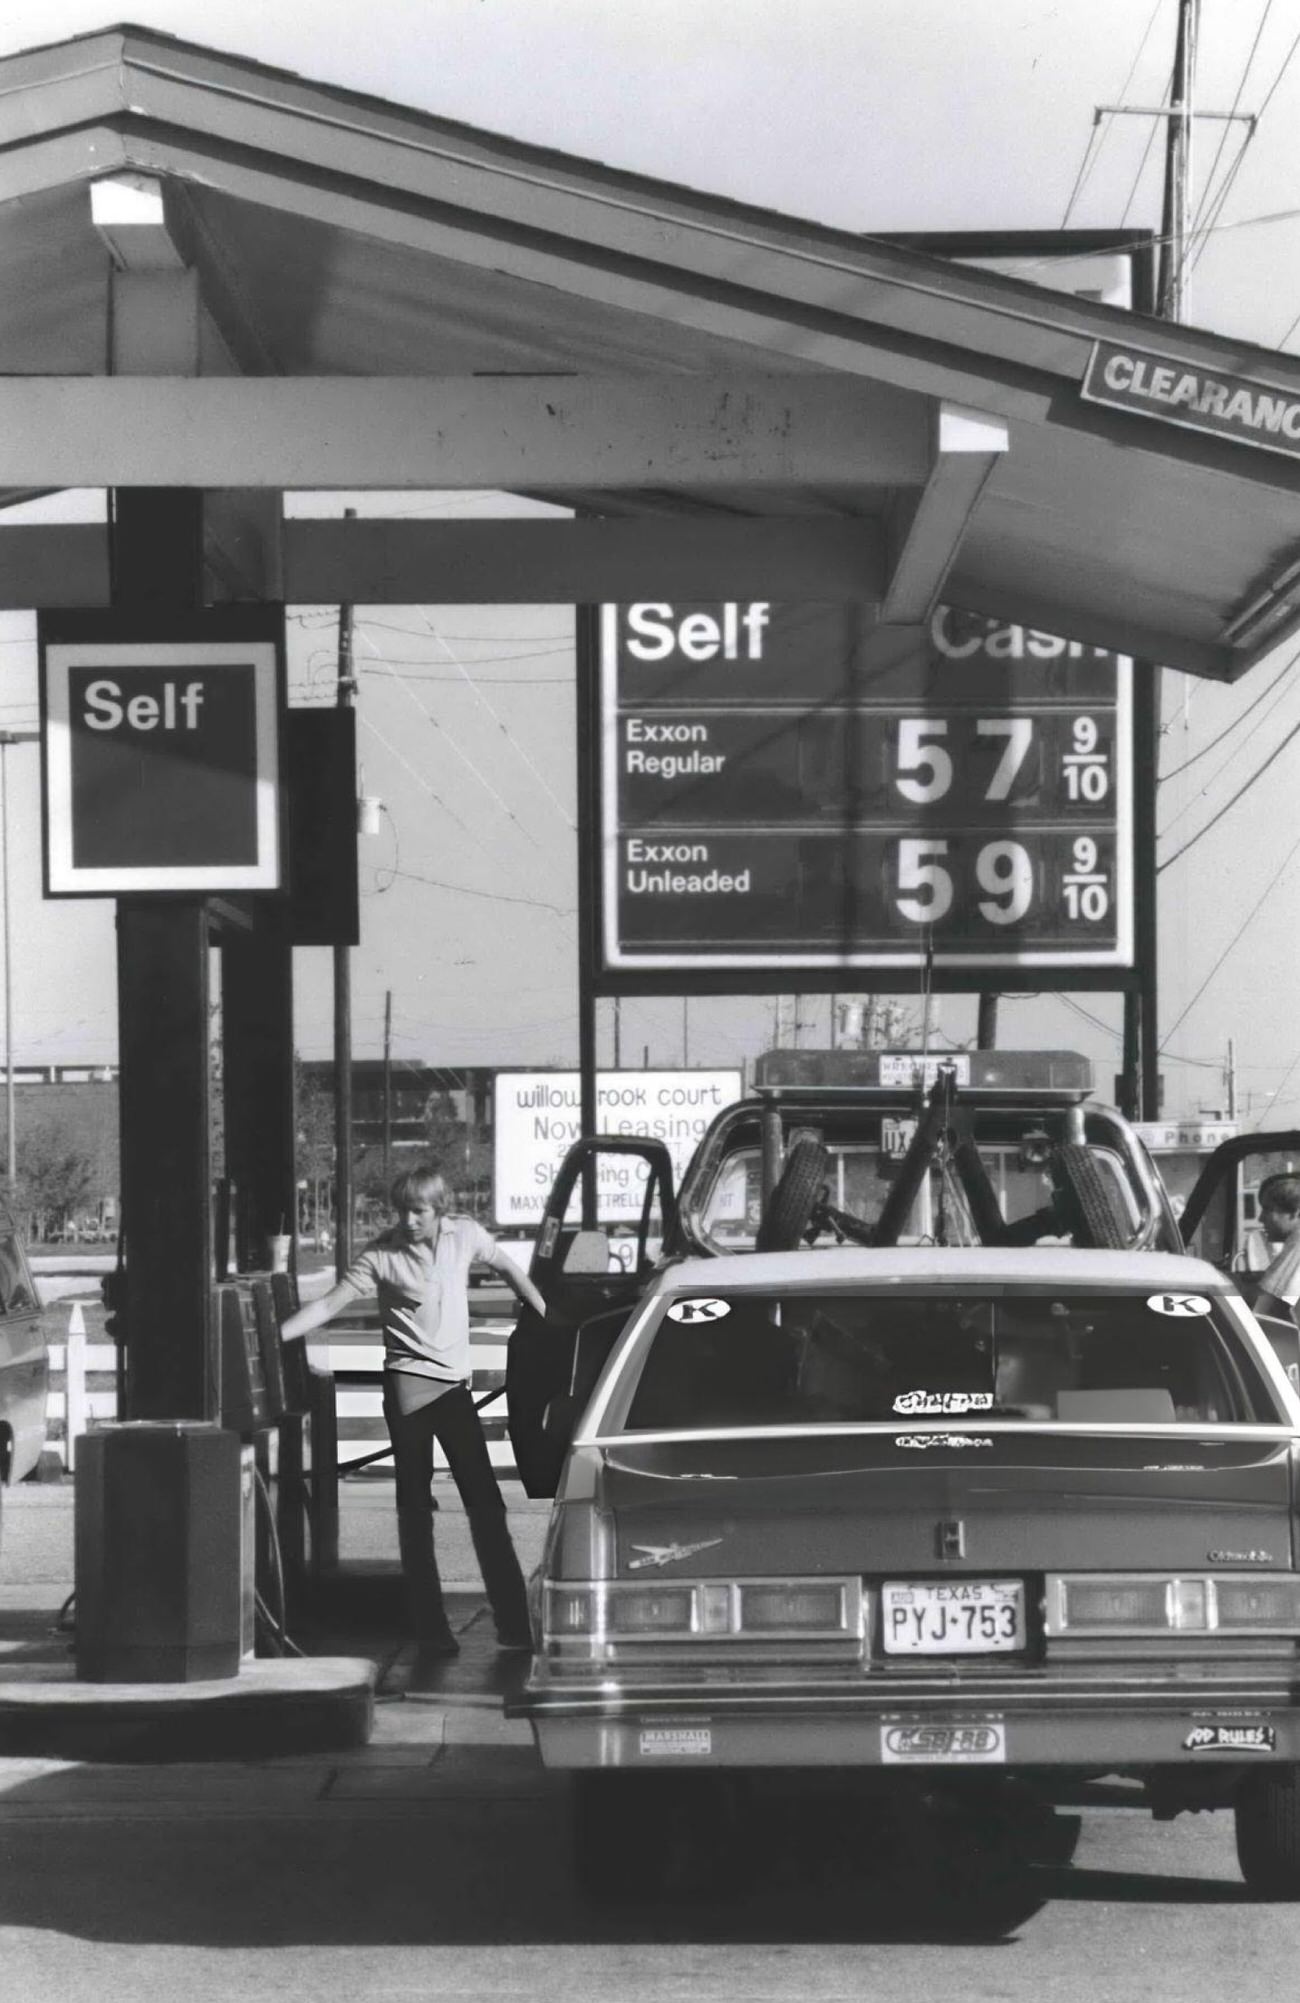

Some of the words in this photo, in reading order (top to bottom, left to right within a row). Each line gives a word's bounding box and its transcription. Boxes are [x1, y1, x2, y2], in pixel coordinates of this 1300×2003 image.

[627, 603, 769, 660] Self
[931, 604, 1108, 658] Cas
[84, 680, 204, 731] Self
[627, 719, 707, 742] Exxon
[627, 752, 725, 777] Regular
[627, 840, 707, 863] Exxon
[627, 871, 750, 893] Unleaded
[517, 1085, 647, 1108] willowrook
[658, 1085, 722, 1106] court
[1165, 1131, 1230, 1143] Phone
[926, 1586, 983, 1601] TEXAS
